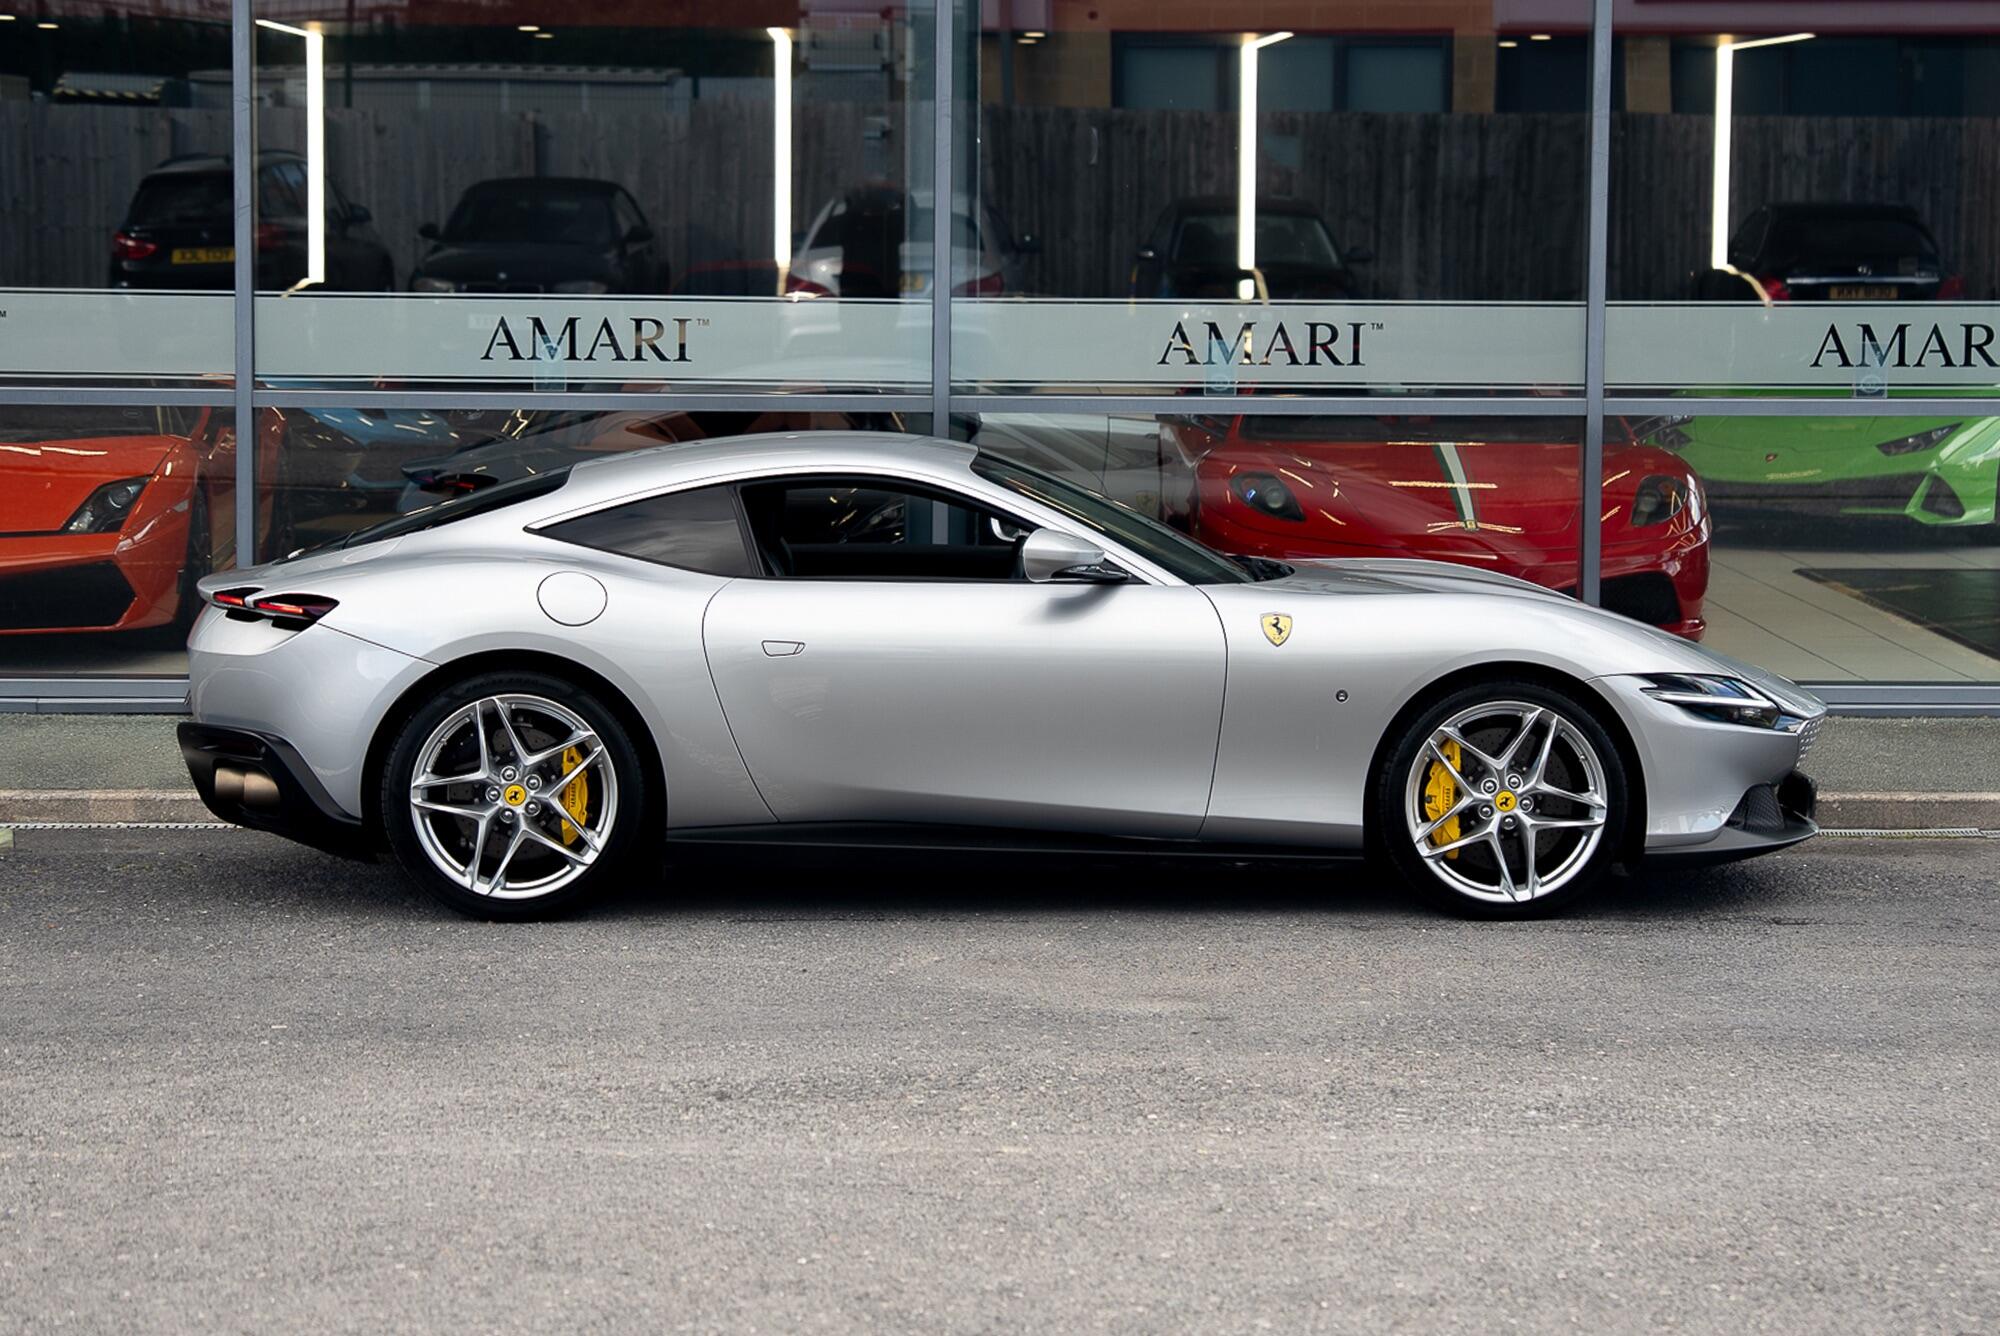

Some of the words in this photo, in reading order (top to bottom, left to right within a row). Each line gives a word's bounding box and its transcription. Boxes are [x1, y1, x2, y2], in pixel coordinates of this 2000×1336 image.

[480, 316, 692, 362] AMARI
[1156, 321, 1366, 366] AMARI
[1809, 323, 2000, 367] AMAR
